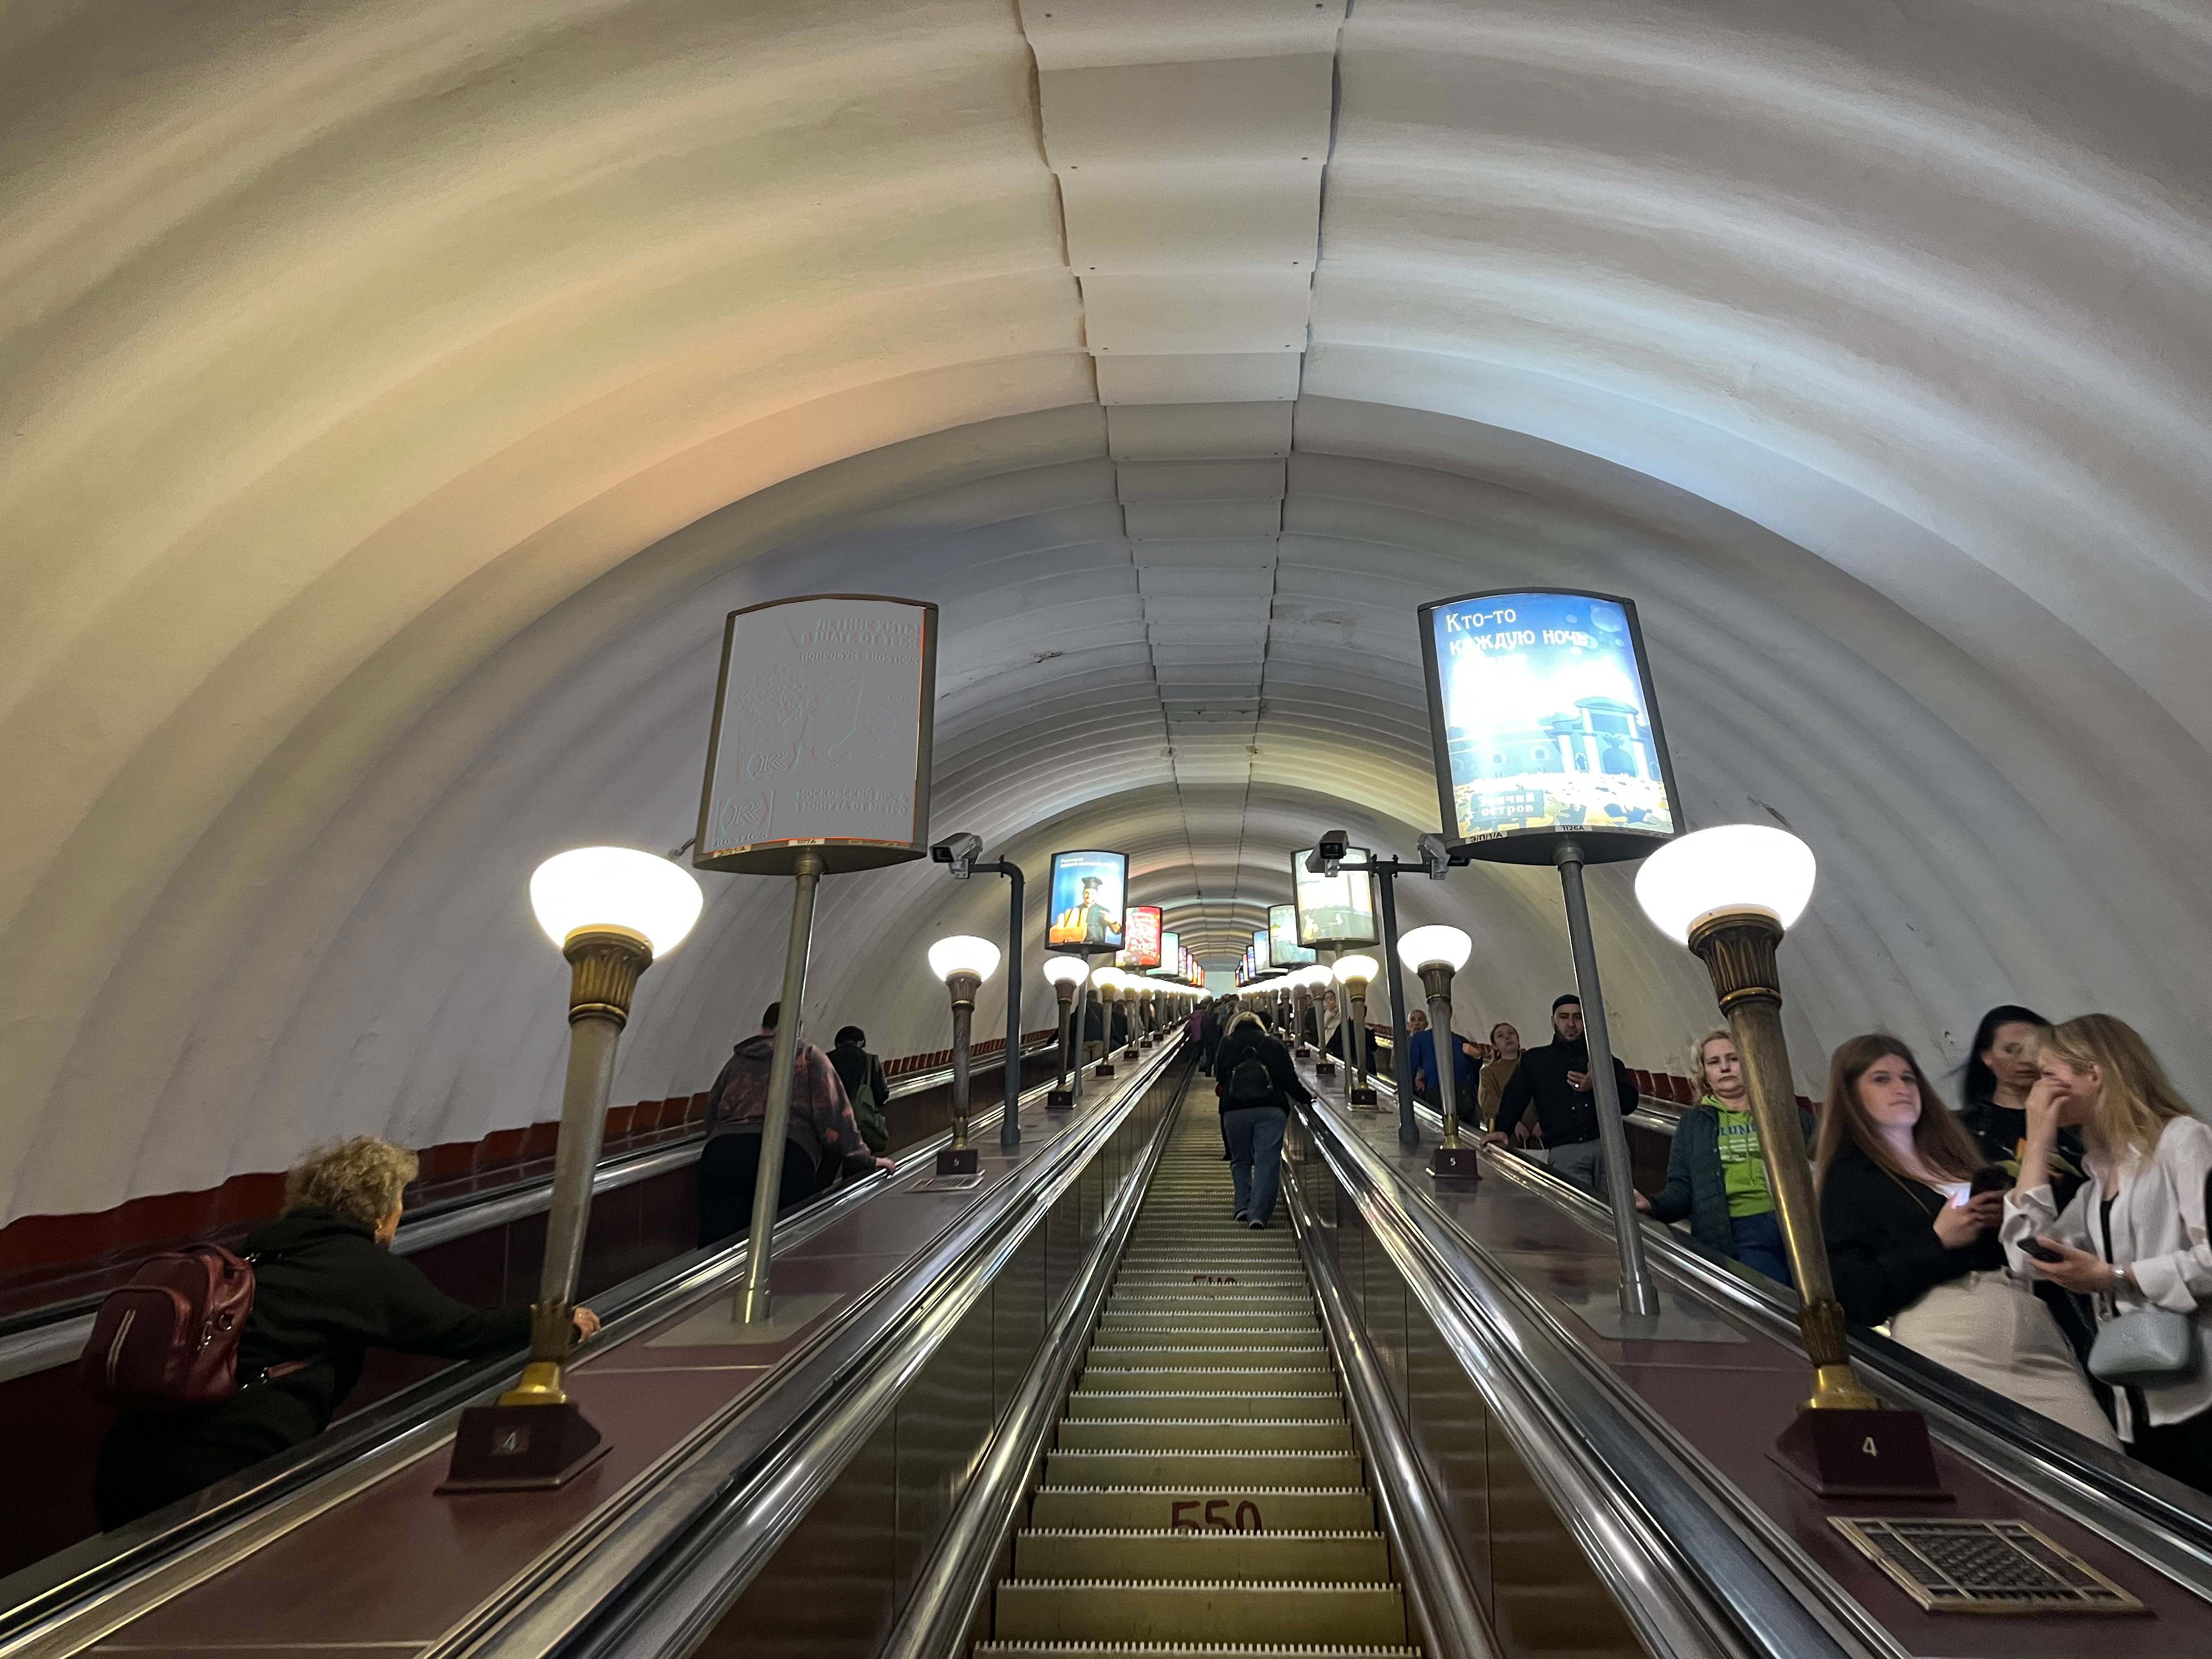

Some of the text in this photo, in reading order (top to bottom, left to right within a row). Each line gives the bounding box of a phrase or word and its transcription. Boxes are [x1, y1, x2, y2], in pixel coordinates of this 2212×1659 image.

[816, 619, 921, 635] ЛЕТНИЕ ХИТЫ
[1446, 609, 1516, 632] Кто-то
[859, 631, 881, 646] ОТ
[800, 648, 858, 662] ПОПРОБУЙ
[795, 786, 876, 800] МОСКОВСКИЙ
[1478, 792, 1535, 807] Зчий
[803, 799, 850, 812] МИНУТА
[1481, 804, 1534, 816] остров
[1450, 1157, 1457, 1166] 5
[503, 1430, 517, 1451] 4
[1861, 1436, 1878, 1457] 4
[1172, 1500, 1263, 1534] 550
